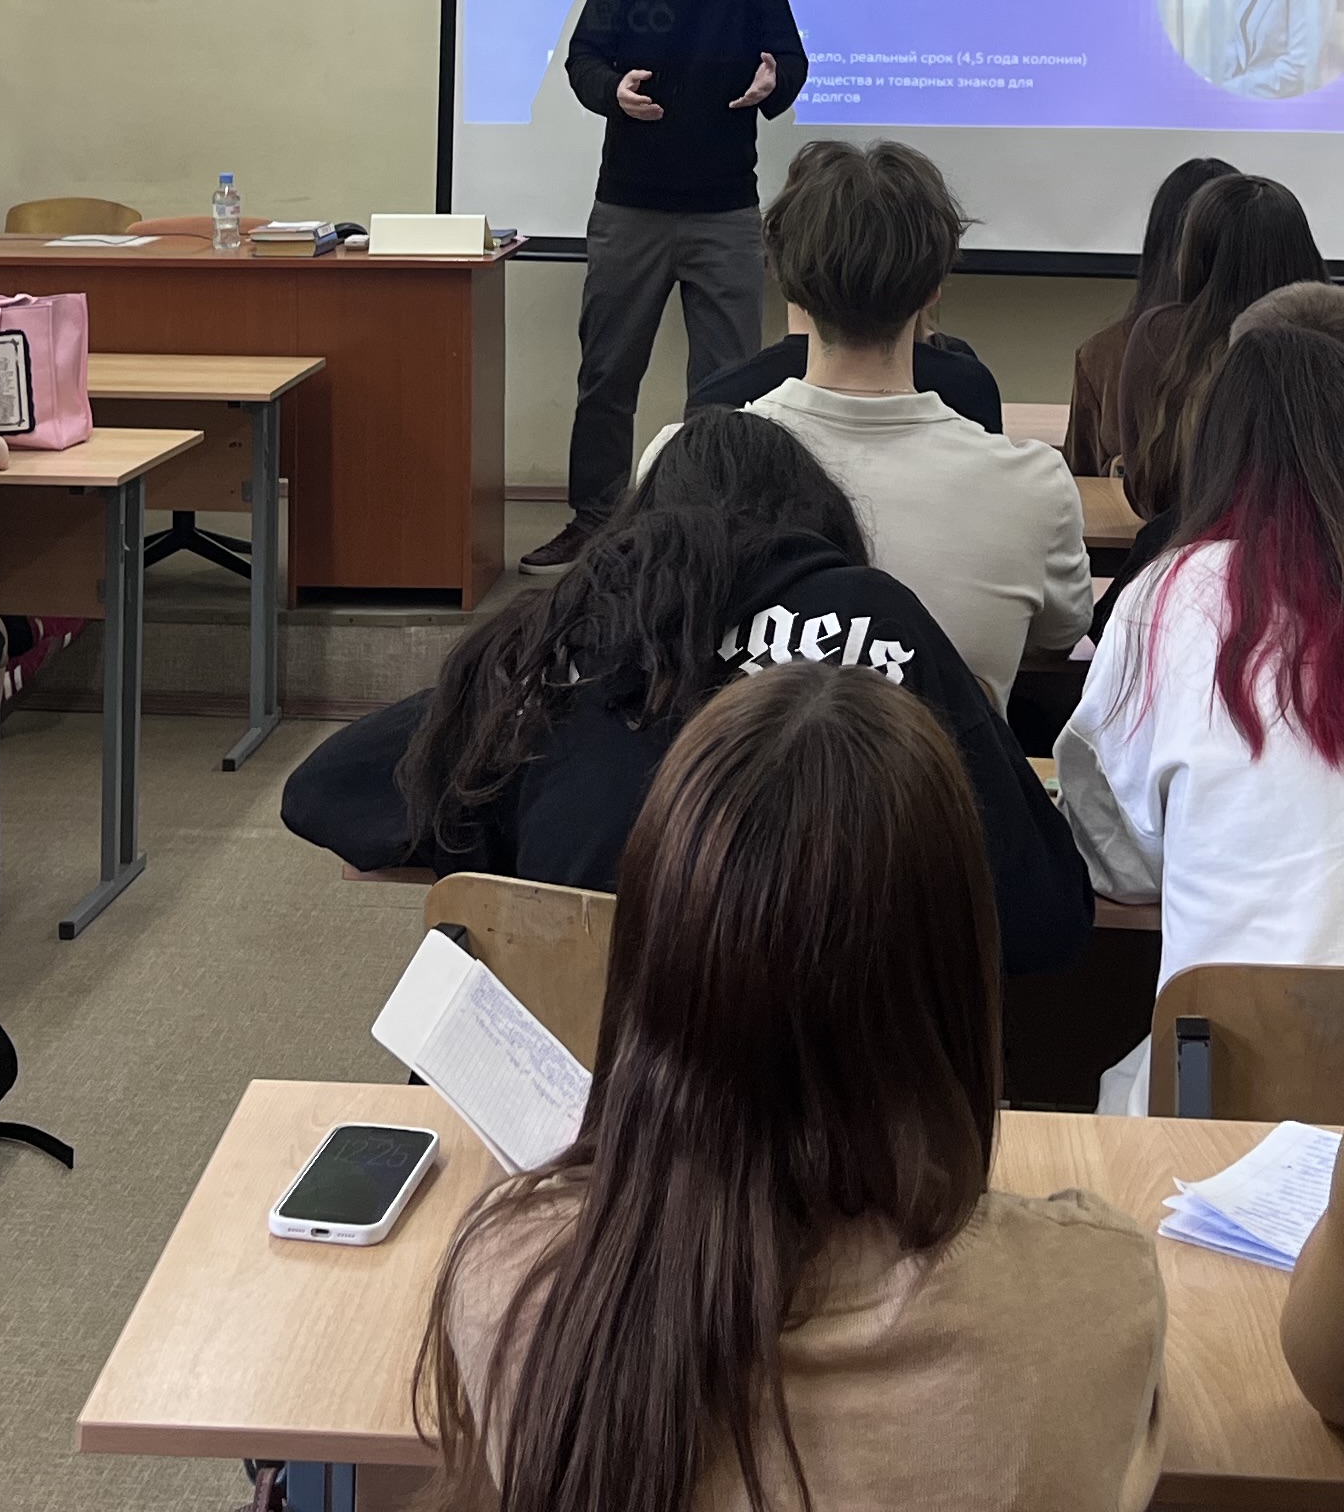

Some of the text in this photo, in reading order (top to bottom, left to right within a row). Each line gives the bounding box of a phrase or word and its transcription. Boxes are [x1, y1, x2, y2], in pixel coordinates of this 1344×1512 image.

[808, 51, 1087, 67] дело, реальный срок (4,5 года колонии)
[807, 76, 873, 89] мущества
[888, 77, 953, 90] товарных
[957, 78, 1005, 88] знаков
[1007, 78, 1034, 90] для
[812, 92, 861, 104] долгов
[717, 604, 915, 685] gels
